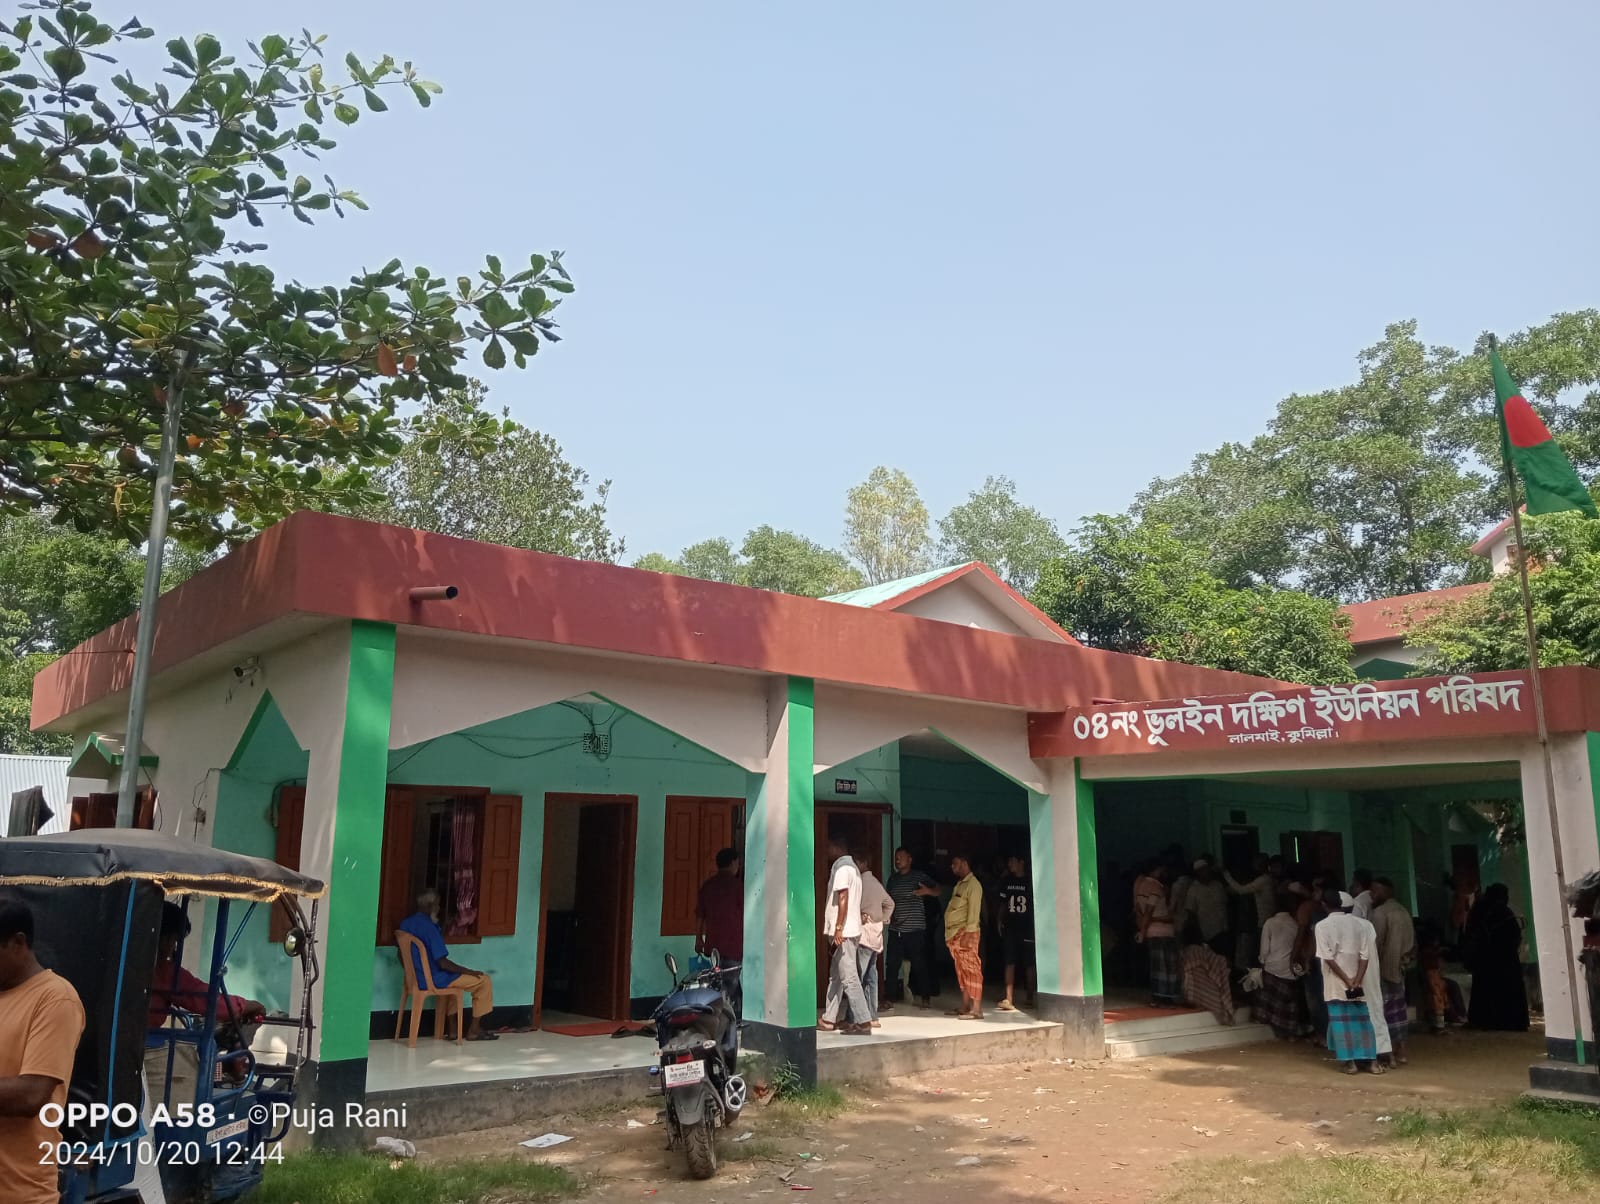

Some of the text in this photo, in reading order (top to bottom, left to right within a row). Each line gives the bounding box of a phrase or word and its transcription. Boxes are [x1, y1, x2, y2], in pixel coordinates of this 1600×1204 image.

[1143, 698, 1224, 747] ভূলইন
[1228, 691, 1306, 729] দক্ষিণ
[1310, 683, 1420, 726] ইউনিয়ন
[1426, 675, 1524, 715] পরিষদ
[1008, 895, 1027, 913] 43
